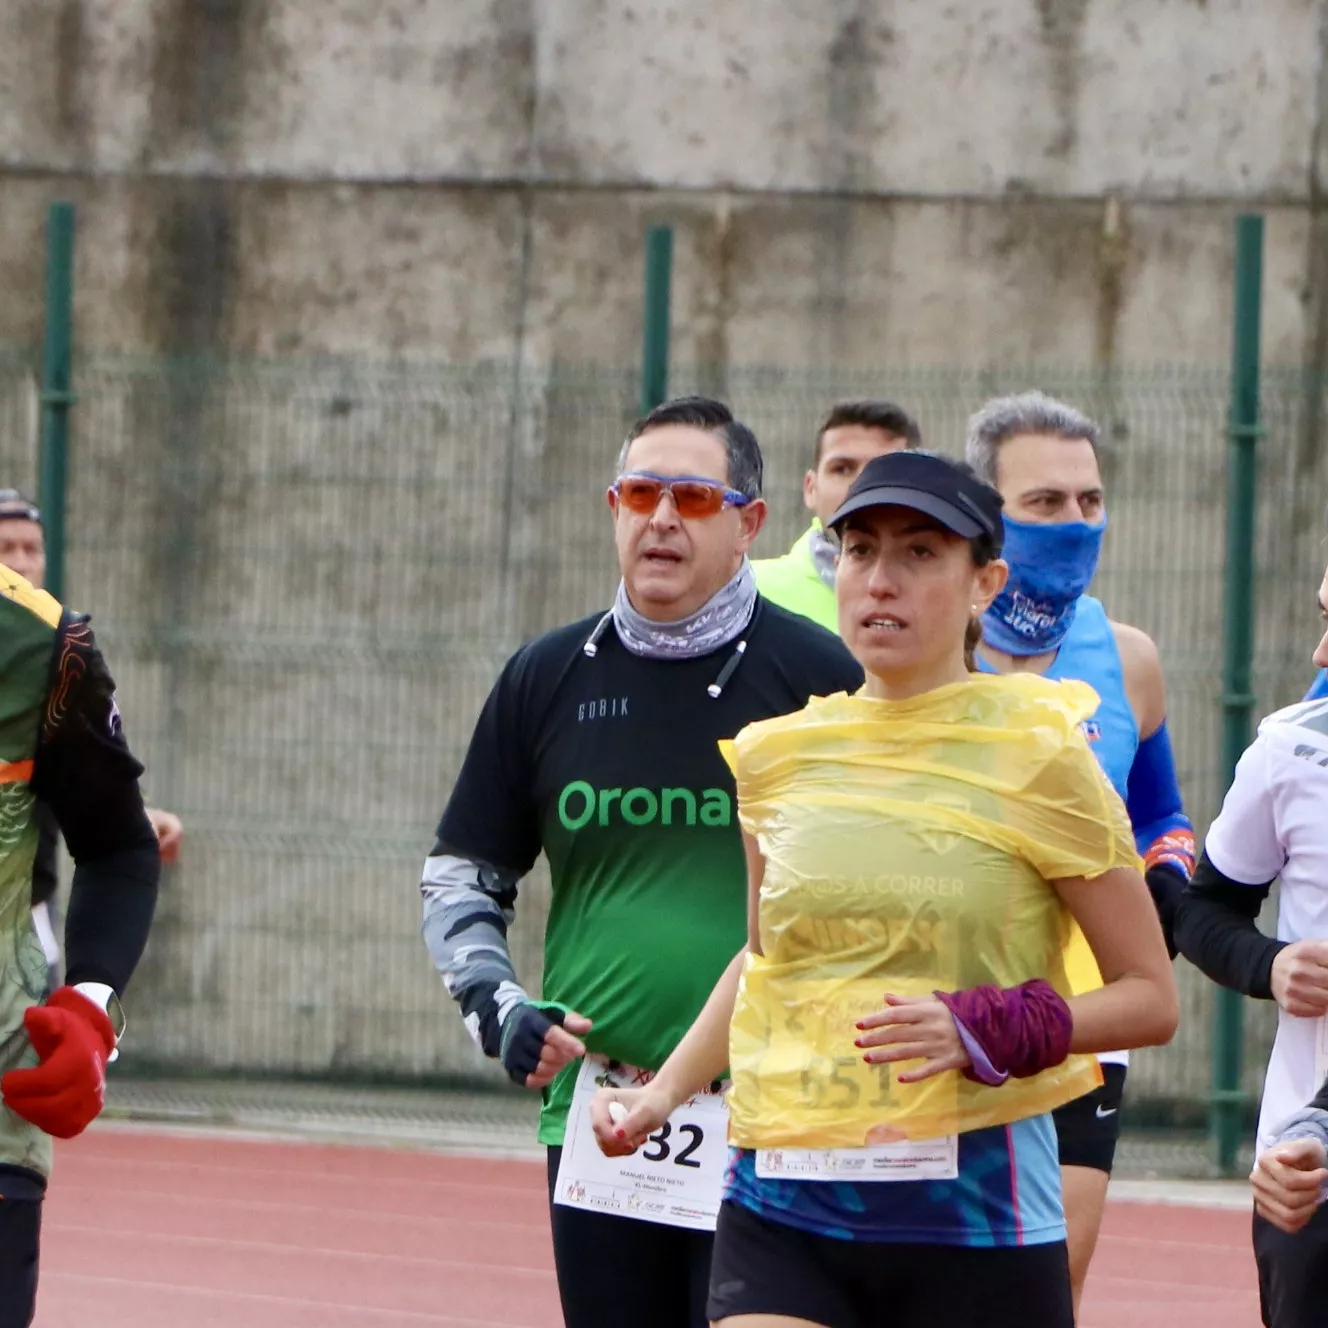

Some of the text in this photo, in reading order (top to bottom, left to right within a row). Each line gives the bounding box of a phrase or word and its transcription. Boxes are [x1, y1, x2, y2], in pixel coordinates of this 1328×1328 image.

[578, 697, 628, 721] GOBIK
[558, 780, 731, 830] Orona
[874, 874, 965, 898] CORRER
[633, 1120, 704, 1169] 32
